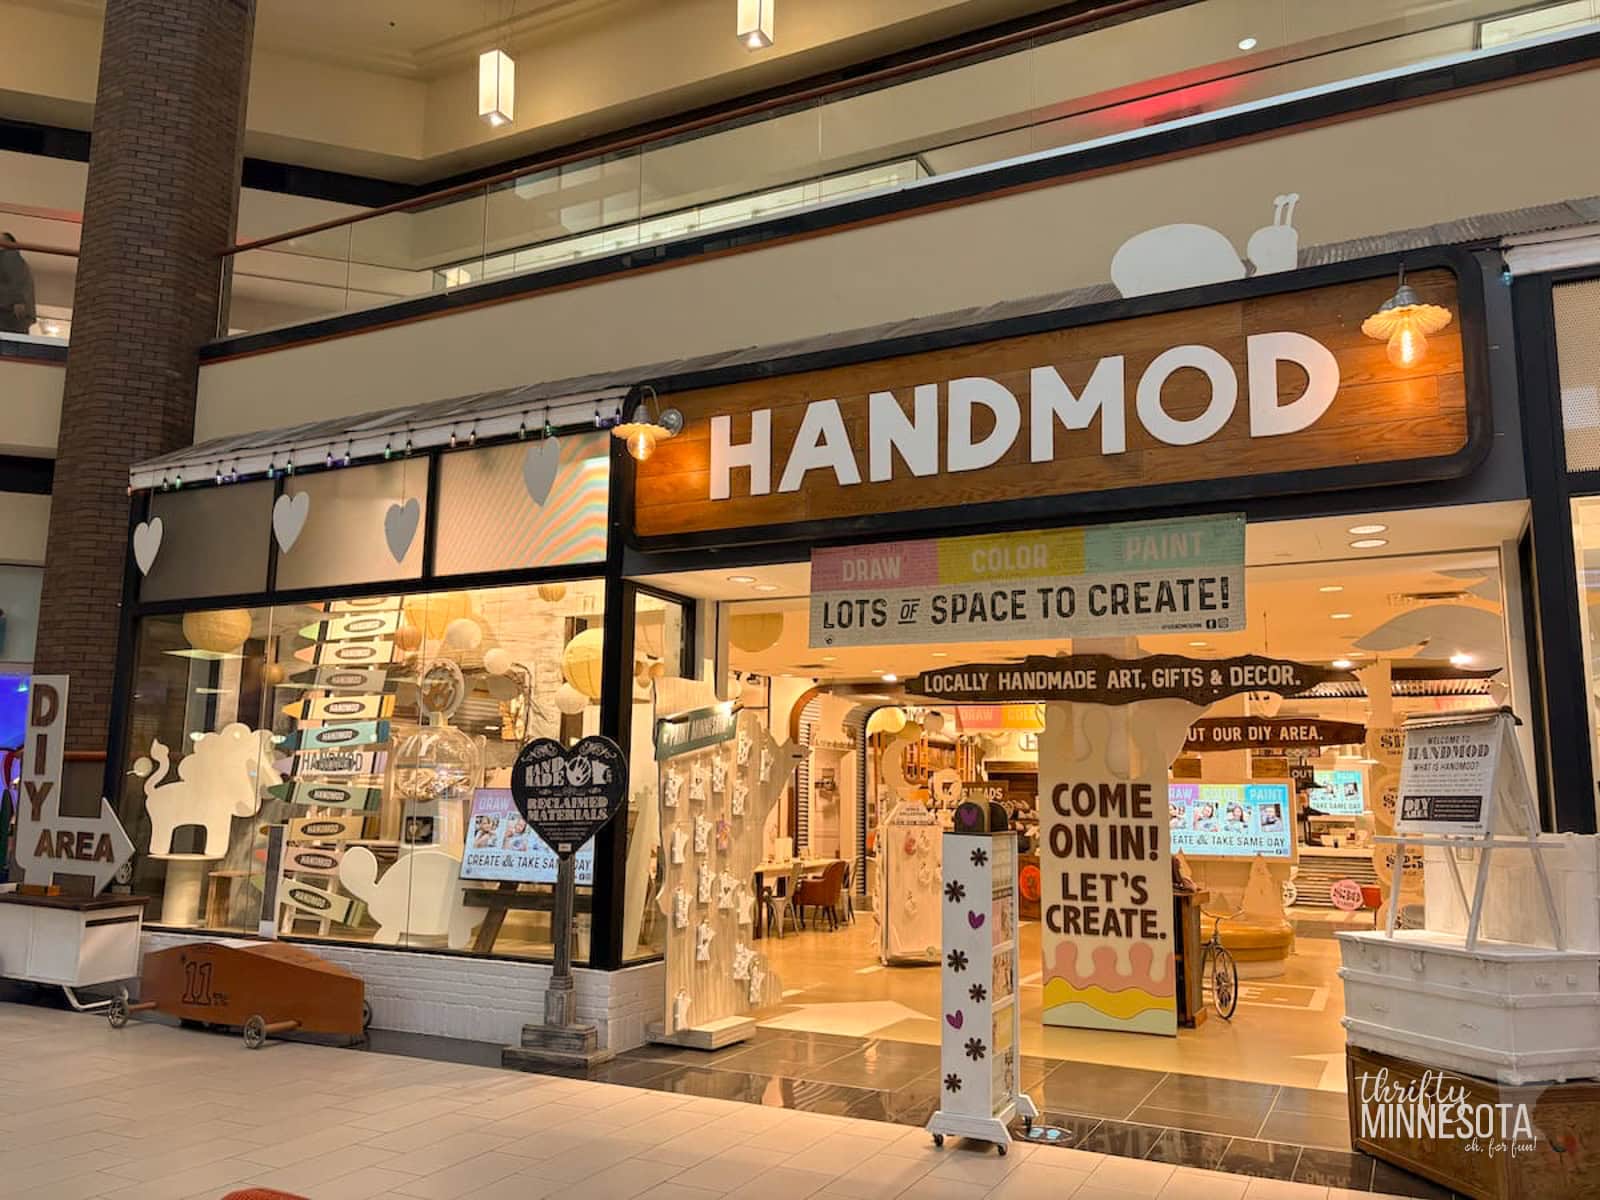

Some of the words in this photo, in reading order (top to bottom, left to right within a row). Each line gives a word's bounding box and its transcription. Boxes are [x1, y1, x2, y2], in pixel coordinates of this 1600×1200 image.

[709, 331, 1340, 500] HANDMOD
[842, 557, 900, 582] DRAW
[970, 544, 1048, 573] COLOR
[1124, 531, 1202, 562] PAINT
[823, 599, 888, 629] LOTS
[899, 603, 919, 621] OF
[931, 589, 1027, 625] SPACE
[1037, 586, 1074, 618] TO
[1088, 576, 1230, 616] CREATE!
[924, 672, 989, 693] LOCALLY
[999, 670, 1097, 691] HANDMADE
[1107, 668, 1147, 690] ART,
[1152, 666, 1203, 688] GIFTS
[1209, 669, 1223, 686] &
[1230, 665, 1301, 686] DECOR.
[1187, 727, 1205, 742] UT
[1213, 727, 1242, 742] OUR
[1248, 726, 1272, 741] DIY
[1279, 725, 1323, 741] AREA.
[24, 683, 59, 821] DIY
[1408, 743, 1490, 760] HANDMOD
[1291, 769, 1312, 779] OUT
[527, 797, 608, 809] RECLAIMED
[1052, 783, 1153, 818] COME
[1168, 787, 1193, 799] RAW
[1249, 787, 1285, 800] PAINT
[527, 808, 608, 821] MATERIALS
[34, 829, 114, 863] AREA
[1049, 823, 1099, 859] ON
[1109, 825, 1158, 861] IN!
[1173, 833, 1195, 845] EATE
[1212, 834, 1233, 846] TAKE
[1236, 835, 1264, 846] SAME
[1266, 835, 1285, 847] DAY
[467, 854, 501, 866] CREATE
[518, 856, 540, 868] TAKE
[542, 858, 555, 869] SA
[1062, 872, 1148, 905] LET'S
[1046, 904, 1167, 940] CREATE.
[182, 961, 212, 1005] 11
